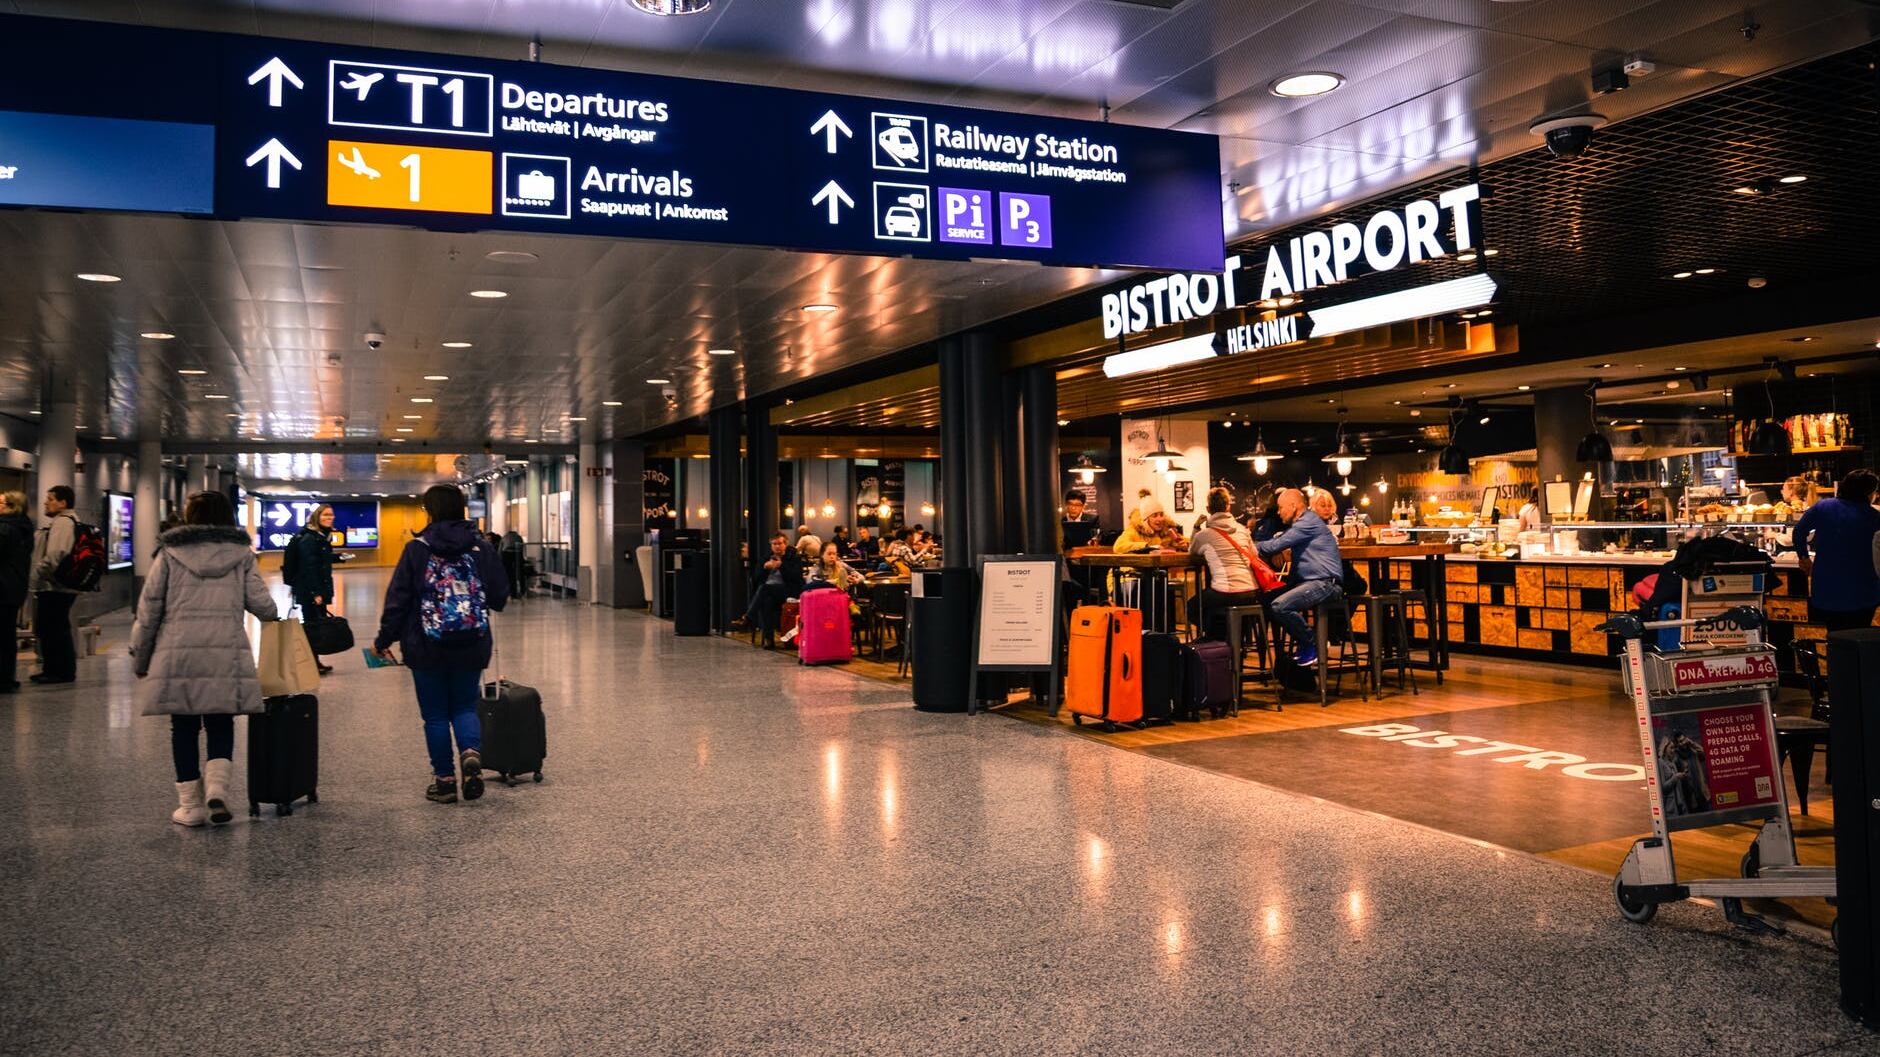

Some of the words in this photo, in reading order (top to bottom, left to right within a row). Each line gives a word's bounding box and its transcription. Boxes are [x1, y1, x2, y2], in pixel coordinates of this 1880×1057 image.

[396, 73, 464, 127] T1
[502, 82, 669, 123] Departures
[502, 116, 571, 136] Lähtevät
[582, 123, 656, 144] Avgångar
[935, 123, 1029, 160] Railway
[1034, 133, 1118, 164] Station
[399, 153, 420, 202] 1
[580, 166, 693, 198] Arrivals
[935, 153, 1027, 175] Rautatieasema
[1036, 165, 1127, 183] Järnvägsstation
[580, 199, 651, 216] Saapuvat
[662, 203, 729, 221] Ankomst
[947, 227, 985, 239] SERVICE
[1101, 256, 1241, 339] BISTROT
[1260, 183, 1480, 300] AIRPORT
[1227, 316, 1298, 355] HELSINKI
[1679, 667, 1704, 680] DNA
[1759, 662, 1773, 673] 4G
[1704, 716, 1733, 726] CHOOSE
[1736, 713, 1754, 722] YOUR
[1706, 728, 1723, 736] OWN
[1743, 724, 1754, 732] FOR
[1708, 737, 1736, 746] PREPAID
[1709, 748, 1719, 756] 4G
[1339, 723, 1648, 790] BISTRO
[1711, 755, 1744, 766] ROAMING
